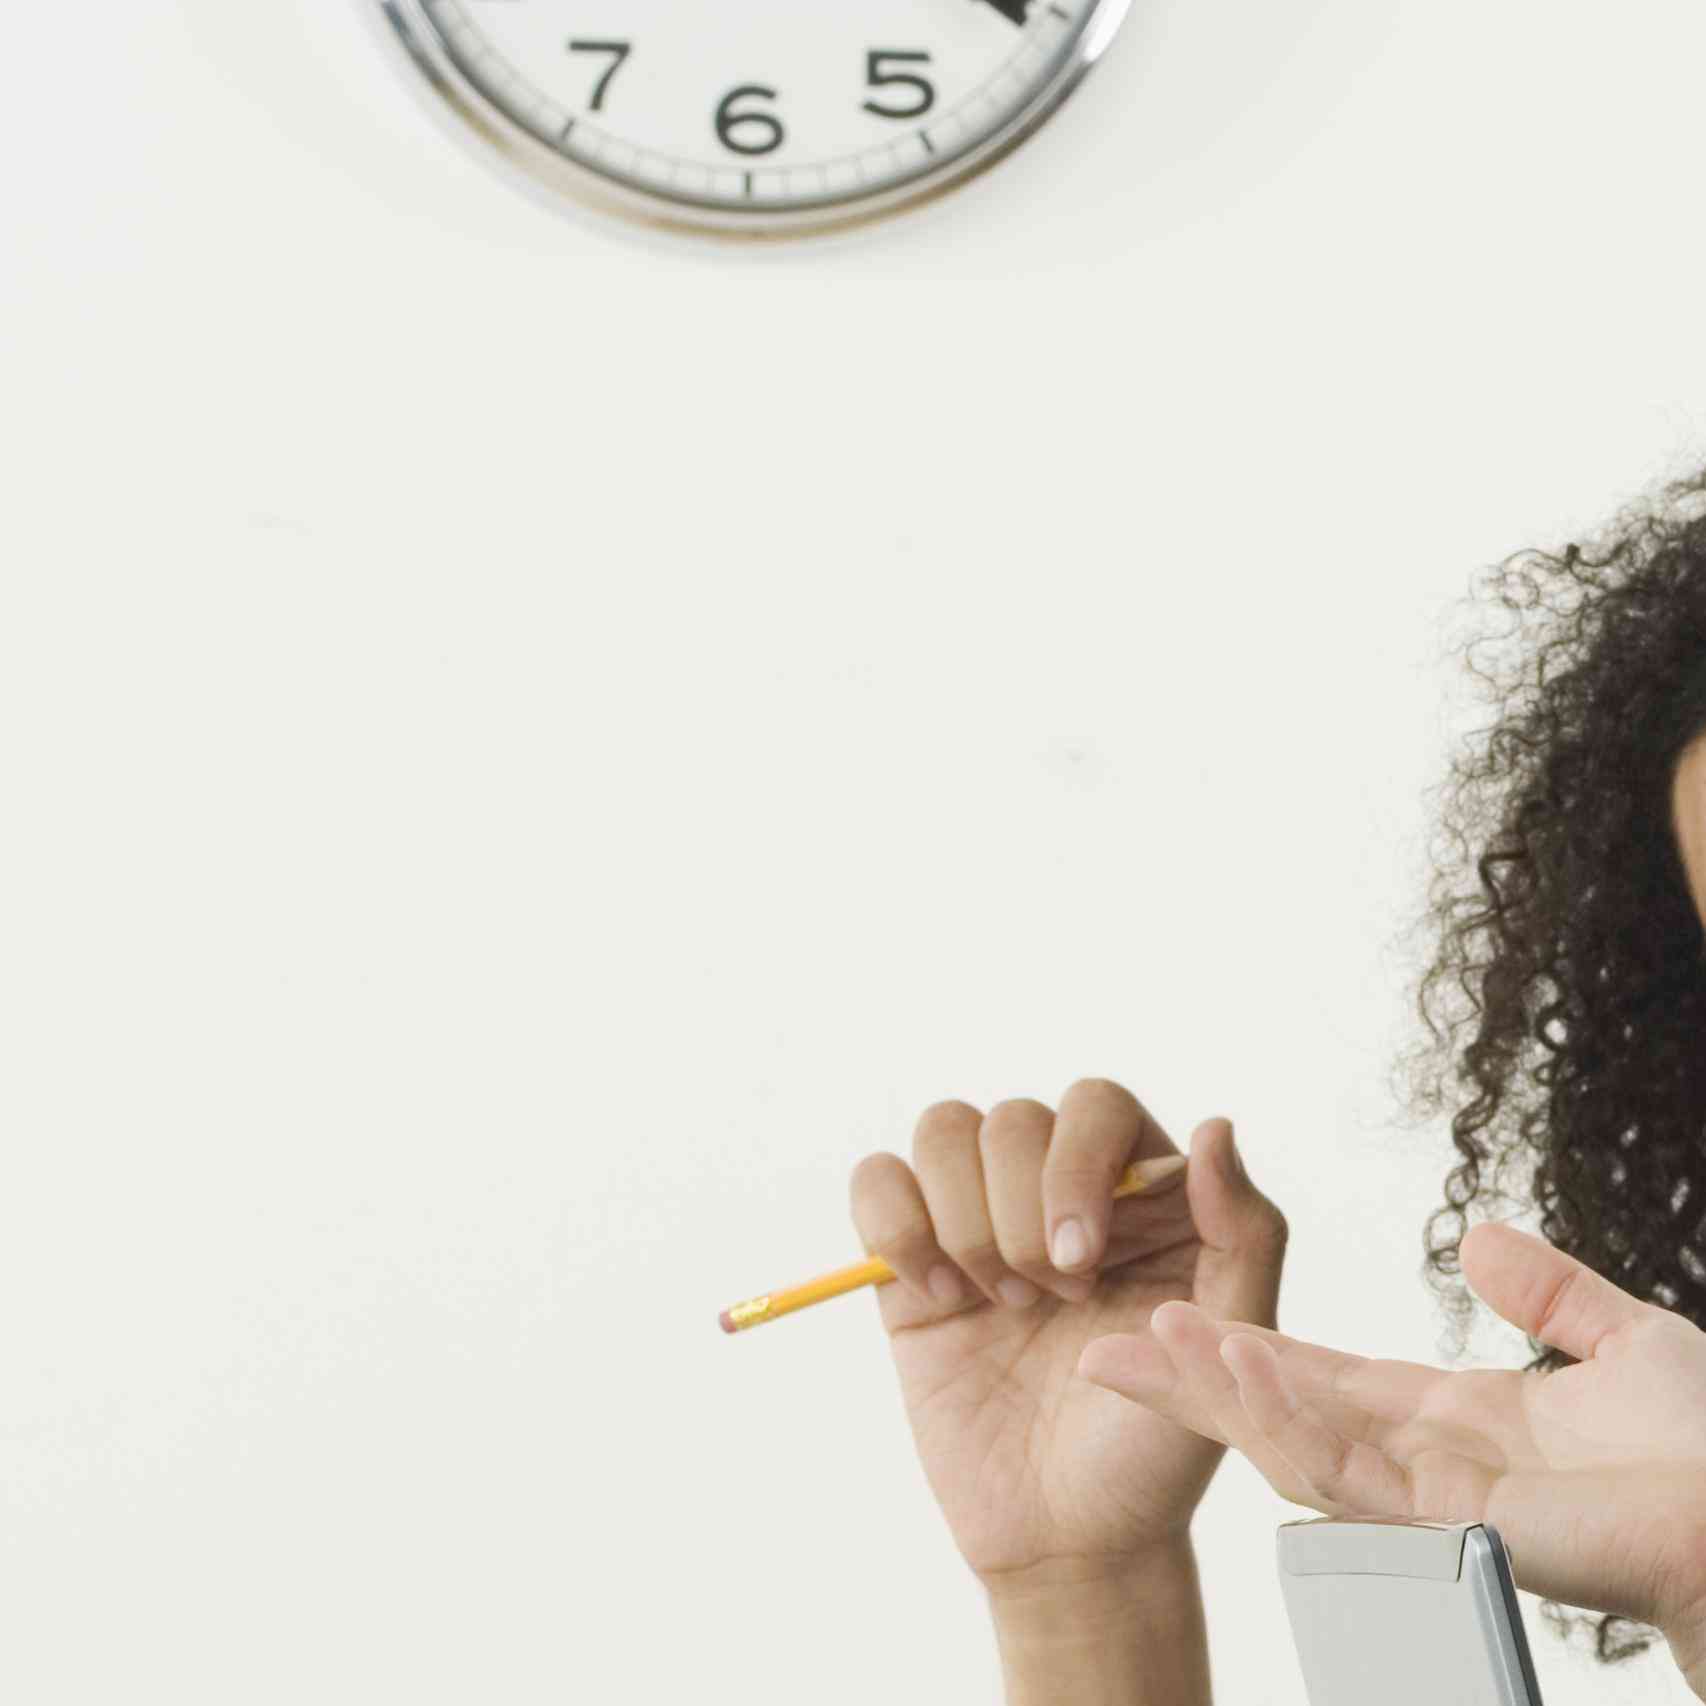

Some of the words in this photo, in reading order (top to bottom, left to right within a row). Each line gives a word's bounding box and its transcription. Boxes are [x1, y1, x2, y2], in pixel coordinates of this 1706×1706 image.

[569, 42, 631, 111] 7
[862, 51, 935, 119] 5
[714, 86, 784, 156] 6
